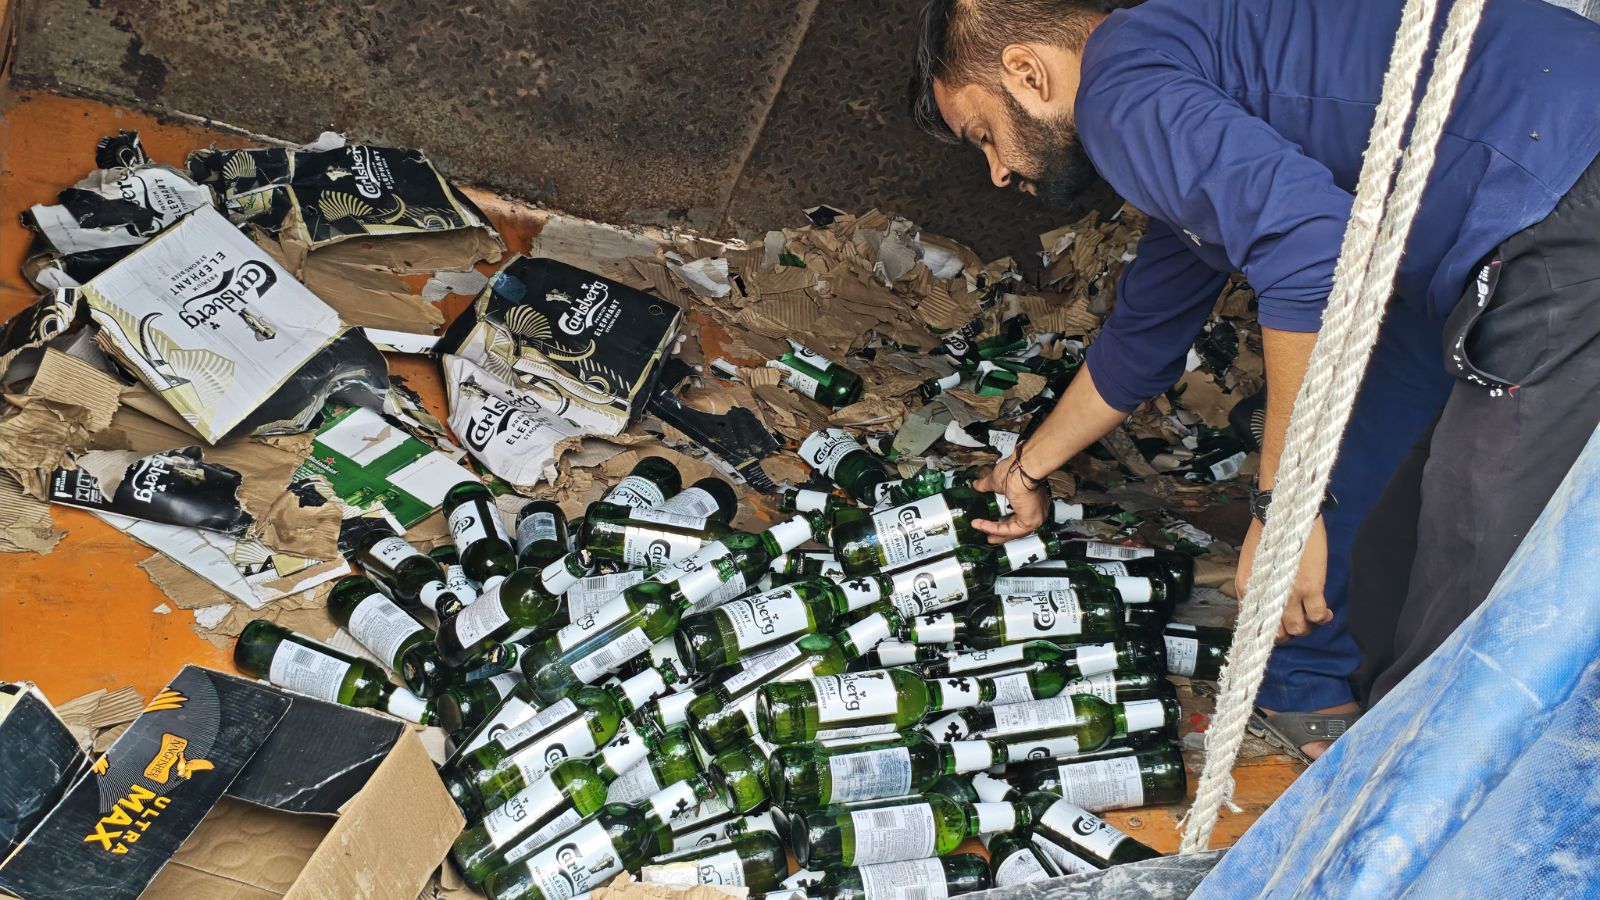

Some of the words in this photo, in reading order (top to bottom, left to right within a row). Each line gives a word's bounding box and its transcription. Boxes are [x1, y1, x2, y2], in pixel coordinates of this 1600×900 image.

[351, 146, 381, 199] Carlsber
[372, 150, 394, 190] ELEPHANT
[170, 251, 226, 296] ELEPHANT
[170, 269, 187, 282] BEER
[187, 254, 208, 271] STRONG
[193, 273, 219, 292] PREMIUM
[178, 259, 277, 330] Carlsberg
[558, 280, 608, 335] Carlsberg
[594, 299, 620, 337] ELEPHANT
[890, 525, 905, 558] ELEPHANT
[898, 505, 924, 559] Carlsber
[147, 738, 186, 778] KINGFISHER
[83, 783, 157, 851] MAX
[111, 796, 172, 854] ULTRA
